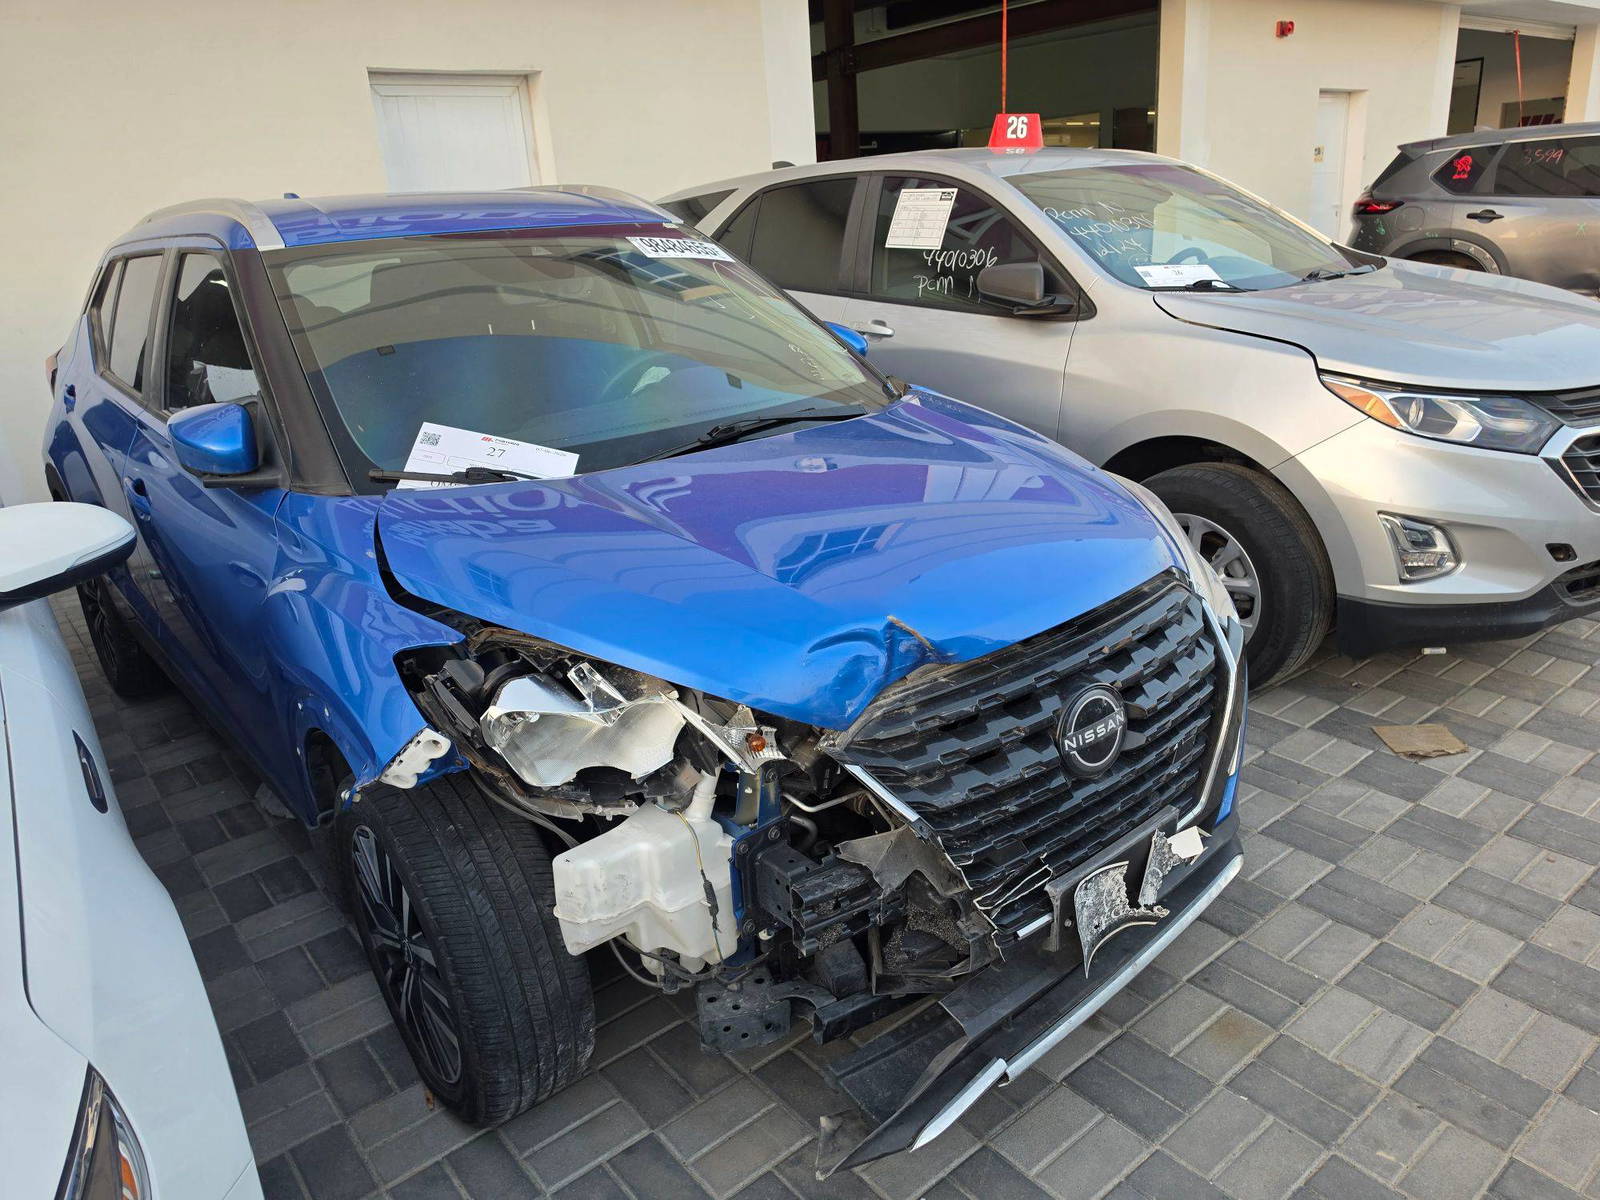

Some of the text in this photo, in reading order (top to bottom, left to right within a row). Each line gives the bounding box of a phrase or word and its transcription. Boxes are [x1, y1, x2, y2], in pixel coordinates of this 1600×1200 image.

[1006, 115, 1028, 139] 26
[486, 446, 506, 458] 27
[1064, 710, 1125, 751] NISSAN
